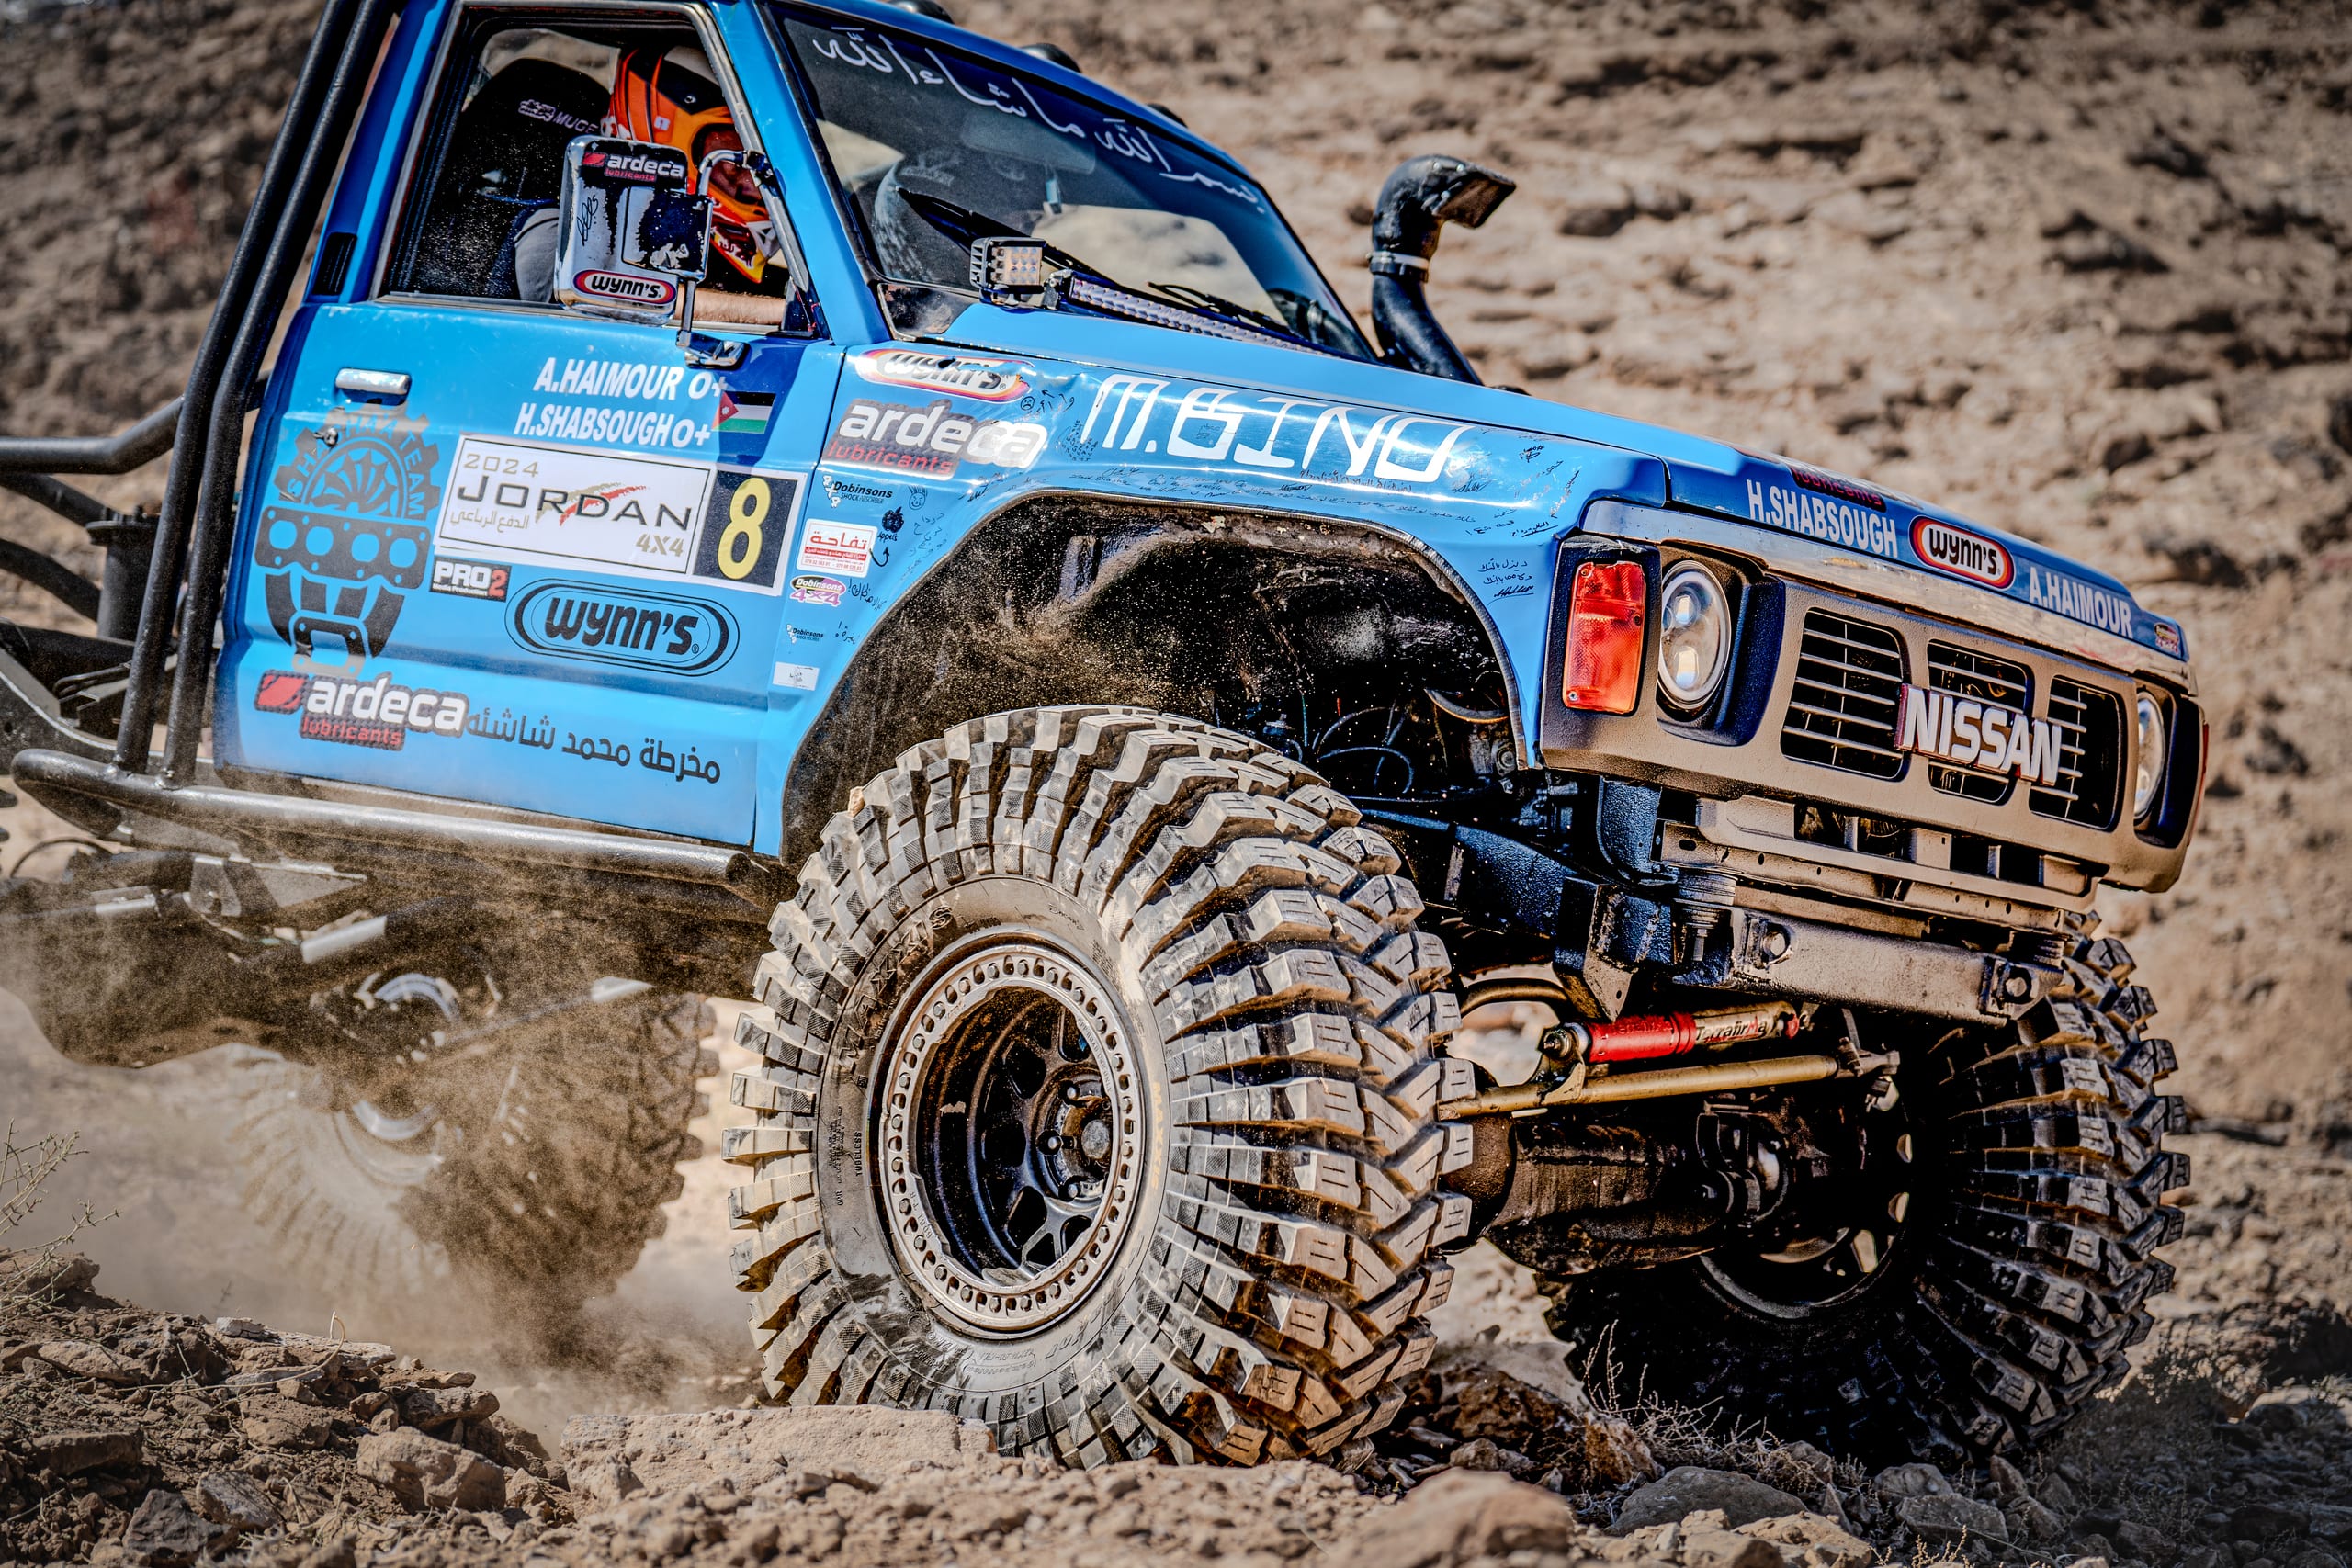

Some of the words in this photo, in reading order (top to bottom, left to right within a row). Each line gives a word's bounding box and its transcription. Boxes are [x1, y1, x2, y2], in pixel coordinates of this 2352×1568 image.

[812, 27, 919, 85] الله
[605, 168, 656, 182] lubricants
[607, 154, 685, 179] ardeca
[533, 357, 684, 400] A.HAIMOUR
[514, 402, 674, 446] H.SHABSOUGH
[839, 404, 1047, 468] ardeca
[461, 453, 539, 478] 2024
[826, 441, 954, 475] lubricants
[457, 474, 693, 532] JORDAN
[833, 481, 893, 499] Dobinsons
[841, 492, 859, 502] SHOCK
[1792, 467, 1883, 506] lubricants
[717, 477, 773, 581] 8
[810, 530, 867, 550] تفاحة
[1746, 479, 1898, 558] H.SHABSOUGH
[796, 578, 842, 592] Dobinsons
[2029, 566, 2133, 639] A.HAIMOUR
[792, 627, 824, 638] Dobinsons
[306, 671, 466, 732] ardeca
[301, 716, 402, 747] lubricants
[561, 731, 631, 767] محمد
[1903, 688, 2062, 786] NISSAN
[639, 738, 721, 784] مخرطة
[837, 907, 954, 1072] MAXXIS
[854, 1131, 863, 1177] TUBELESS
[1150, 1081, 1164, 1190] MAXXIS
